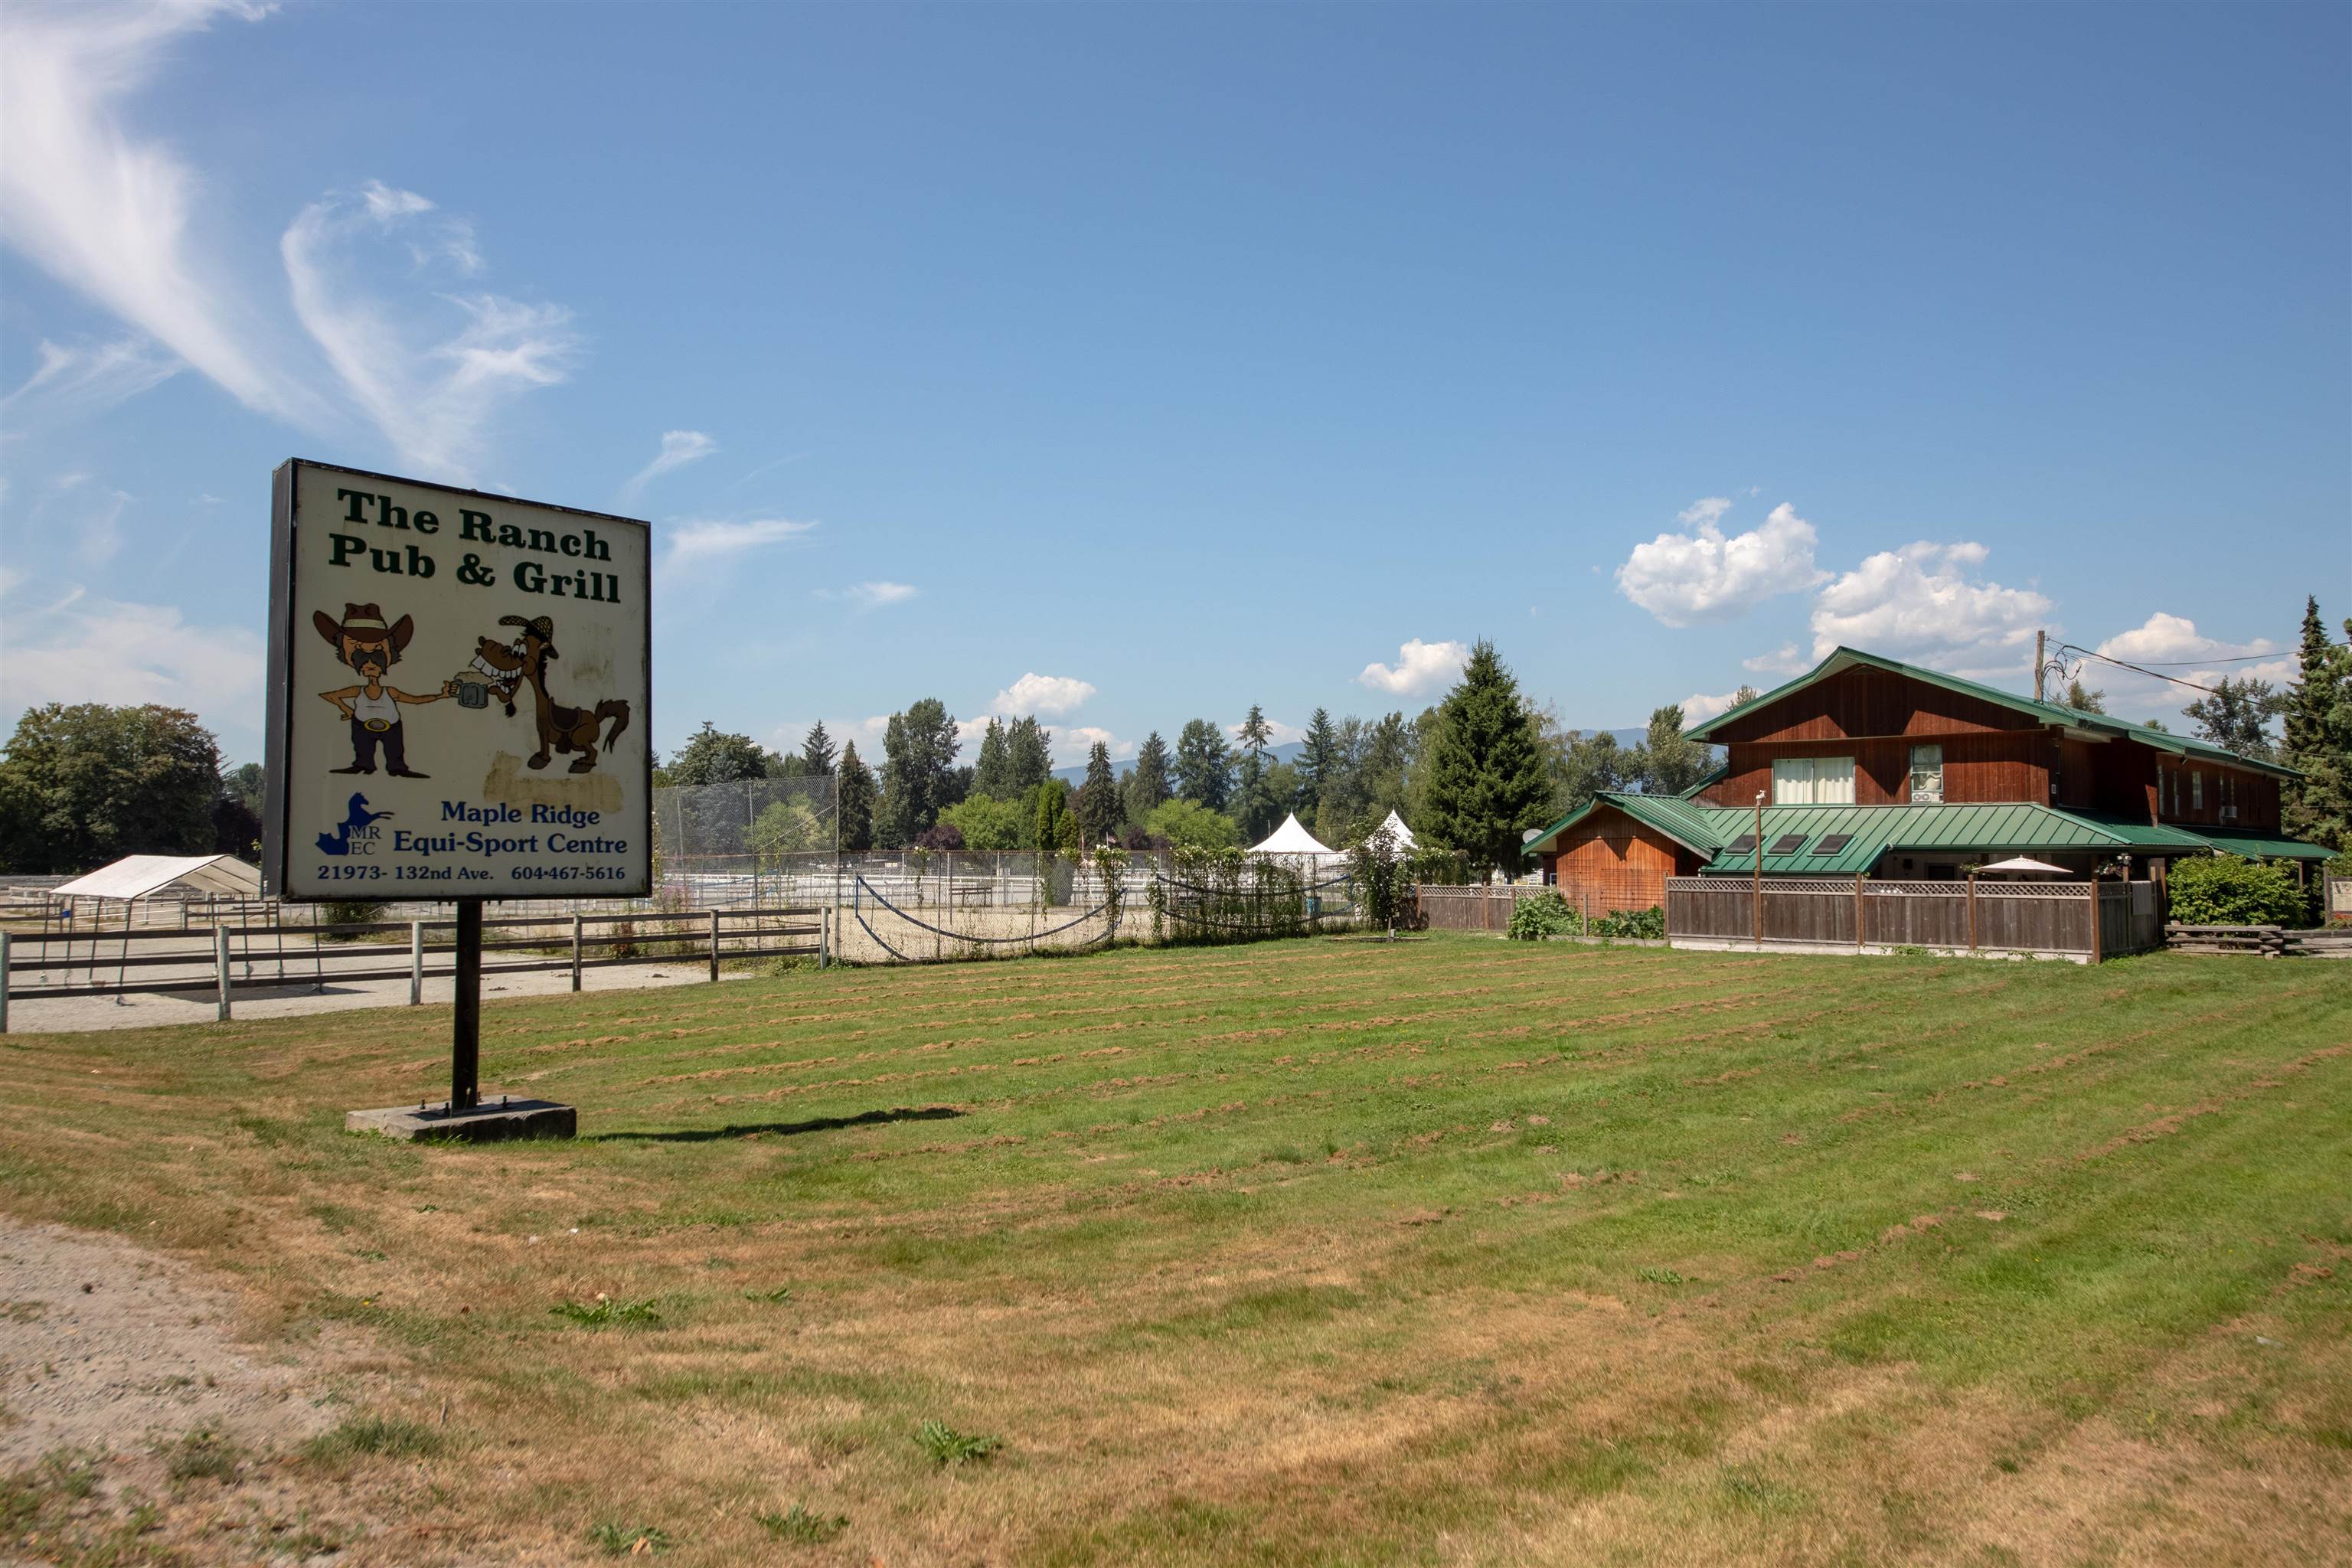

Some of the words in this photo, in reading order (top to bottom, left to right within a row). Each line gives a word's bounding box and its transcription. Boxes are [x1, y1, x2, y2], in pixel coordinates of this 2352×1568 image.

[338, 488, 439, 534] The
[459, 508, 612, 562] Ranch
[328, 532, 436, 578] Pub
[456, 553, 496, 586] &
[513, 561, 621, 603] Grill
[441, 801, 521, 826] Maple
[531, 804, 600, 828] Ridge
[350, 825, 381, 839] MR
[394, 830, 538, 857] Equi-Sport
[547, 833, 628, 854] Centre
[351, 841, 375, 855] EC
[395, 866, 452, 880] 132nd
[457, 867, 494, 880] Ave.
